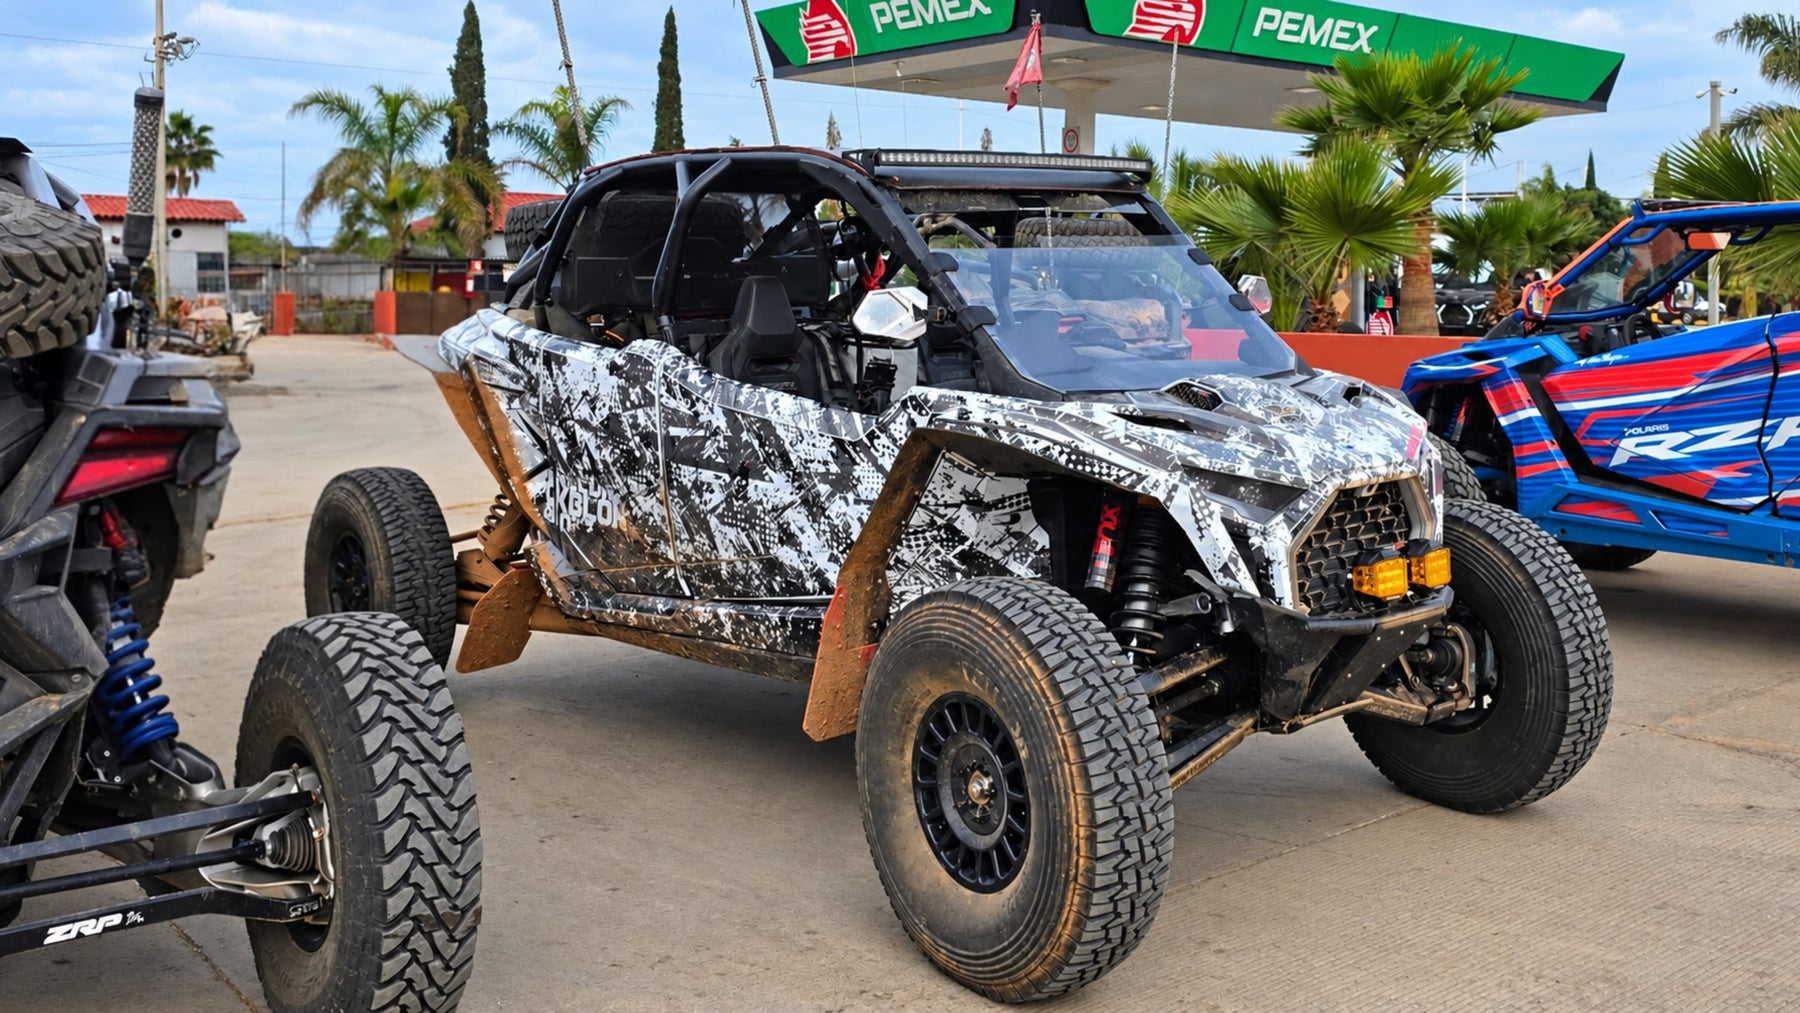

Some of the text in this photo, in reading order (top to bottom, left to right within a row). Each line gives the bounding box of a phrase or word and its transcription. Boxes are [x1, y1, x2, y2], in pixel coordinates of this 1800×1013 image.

[869, 0, 992, 33] PEMEX
[1252, 7, 1379, 54] PEMEX
[43, 912, 123, 945] ZRP
